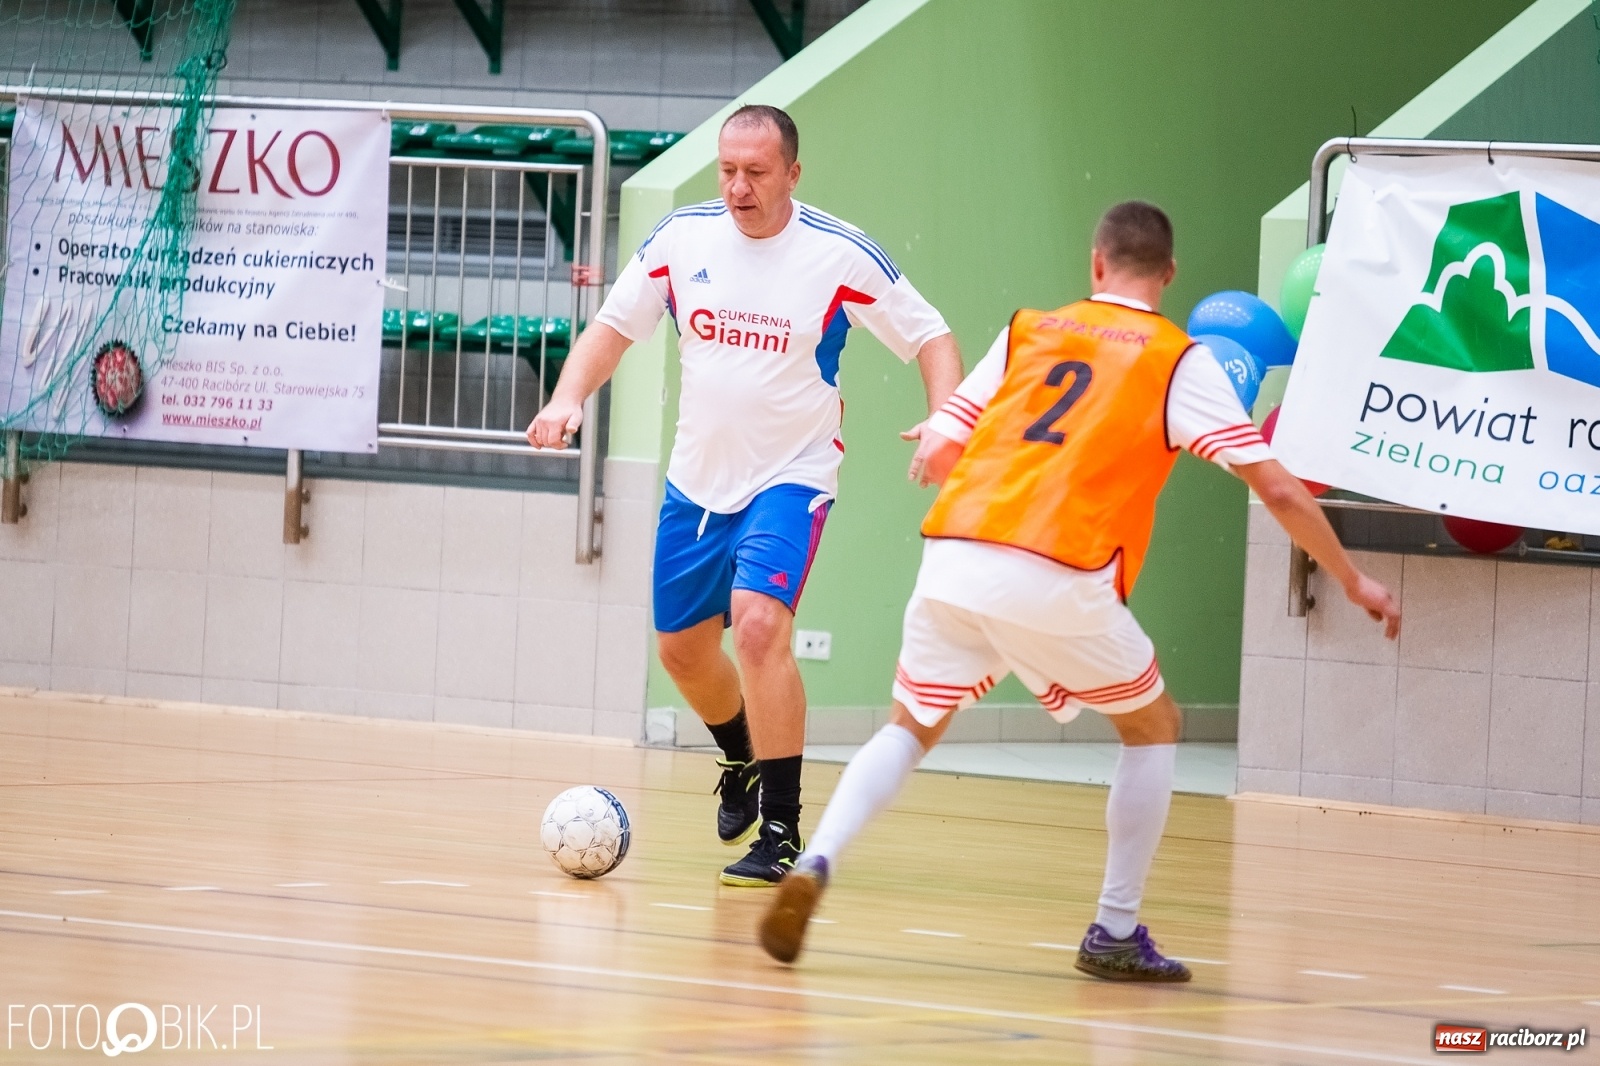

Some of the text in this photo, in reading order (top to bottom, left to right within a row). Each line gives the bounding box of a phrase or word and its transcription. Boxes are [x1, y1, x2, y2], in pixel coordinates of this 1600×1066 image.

[68, 211, 138, 230] poszukuje
[226, 222, 242, 234] na
[245, 221, 319, 237] stanowiska:
[147, 246, 236, 269] urądzeń
[243, 249, 374, 275] cukierniczych
[58, 265, 276, 299] Pracownik produkcyjny
[689, 276, 711, 285] adidas
[162, 315, 357, 342] Czekamy na Ciebie!
[689, 308, 791, 354] Gianni
[718, 309, 792, 330] CUKIERNIA
[161, 358, 283, 377] Mieszko BIS Sp. z o.o.
[161, 375, 199, 390] 47-400
[202, 378, 251, 393] Racibórz
[254, 381, 269, 394] Ul.
[273, 382, 348, 399] Starowiejska
[161, 393, 274, 412] tel. 032 796 11 33
[1022, 360, 1093, 446] 2
[1360, 381, 1538, 445] powiat
[161, 412, 263, 431] www.mieszko.pl
[1350, 430, 1505, 484] zielona
